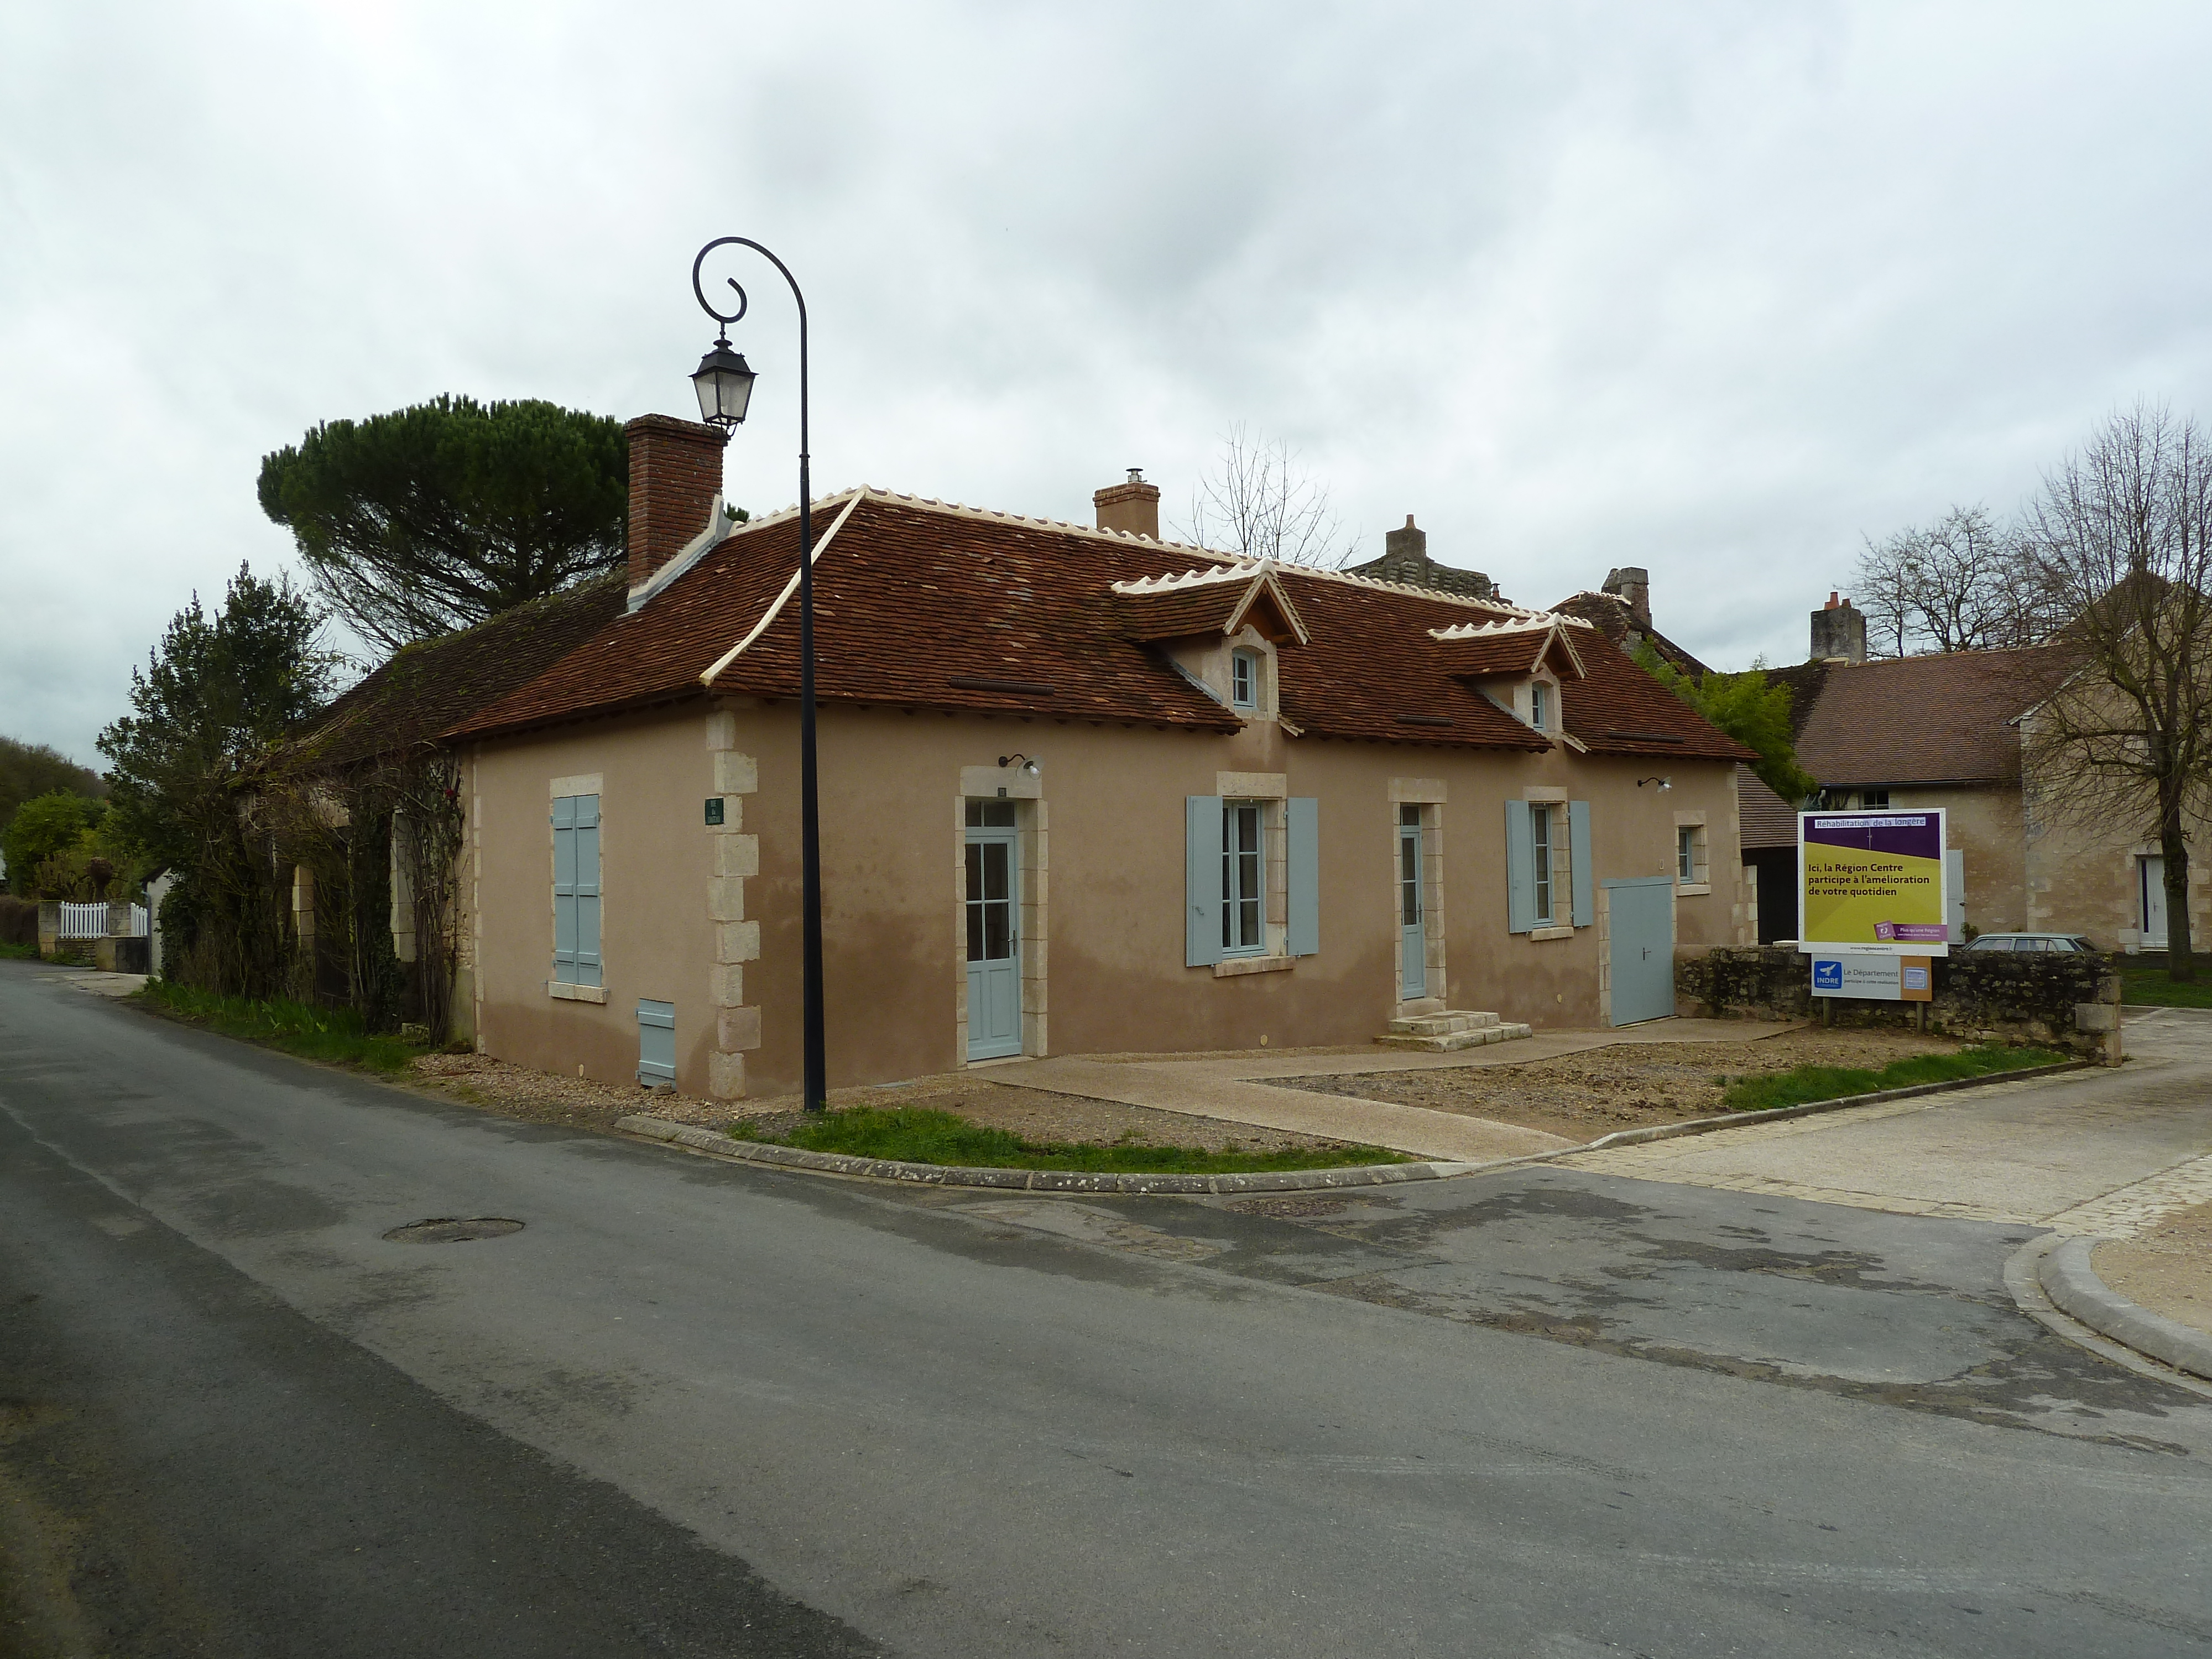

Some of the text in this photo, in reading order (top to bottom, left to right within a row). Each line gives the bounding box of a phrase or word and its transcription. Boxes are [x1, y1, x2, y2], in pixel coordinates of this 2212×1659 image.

[1817, 820, 1869, 828] Réhabilitation
[1808, 864, 1822, 873] Ici,
[1835, 864, 1867, 874] Région
[1808, 876, 1851, 885] participe
[1862, 875, 1930, 883] l'amélioration
[1808, 887, 1820, 895] de
[1850, 887, 1897, 898] quotidien
[1854, 969, 1898, 977] Département
